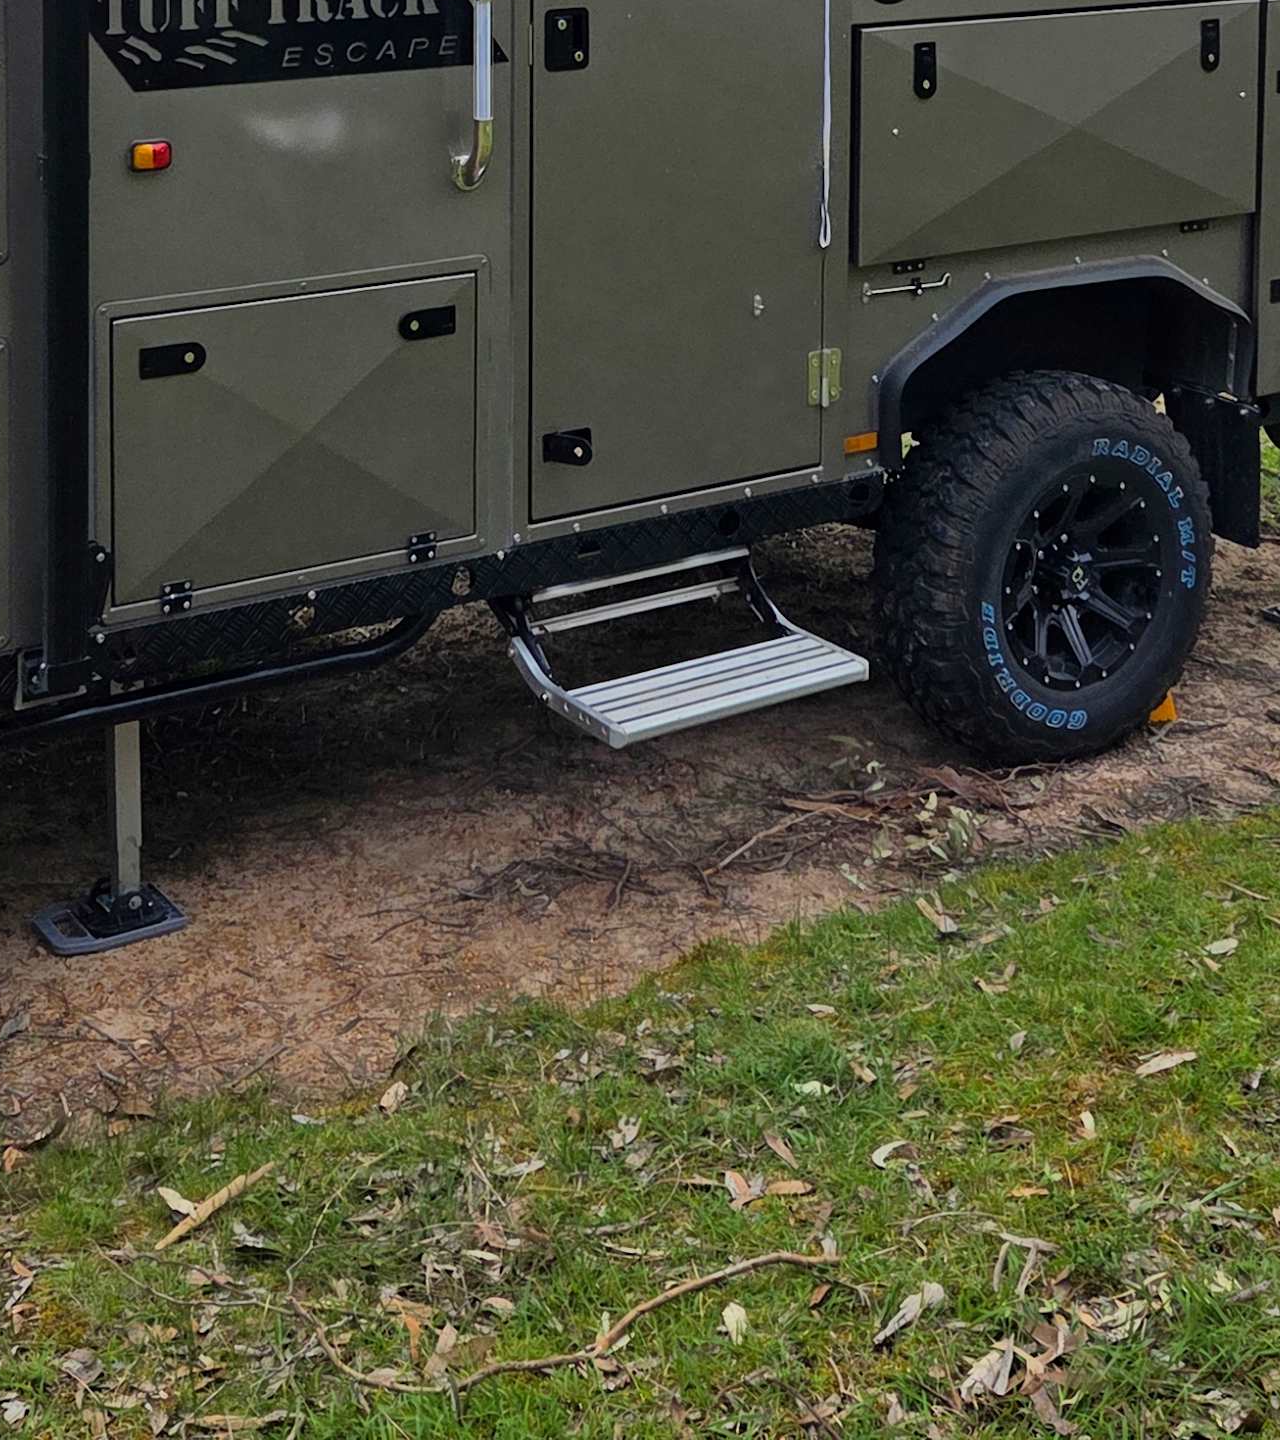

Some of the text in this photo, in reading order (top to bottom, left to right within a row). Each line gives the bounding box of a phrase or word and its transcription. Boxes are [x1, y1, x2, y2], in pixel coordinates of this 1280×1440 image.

[281, 34, 459, 68] ESCAPE
[1091, 437, 1196, 589] RADIAL M/T
[981, 600, 1089, 730] GOODRIDE
